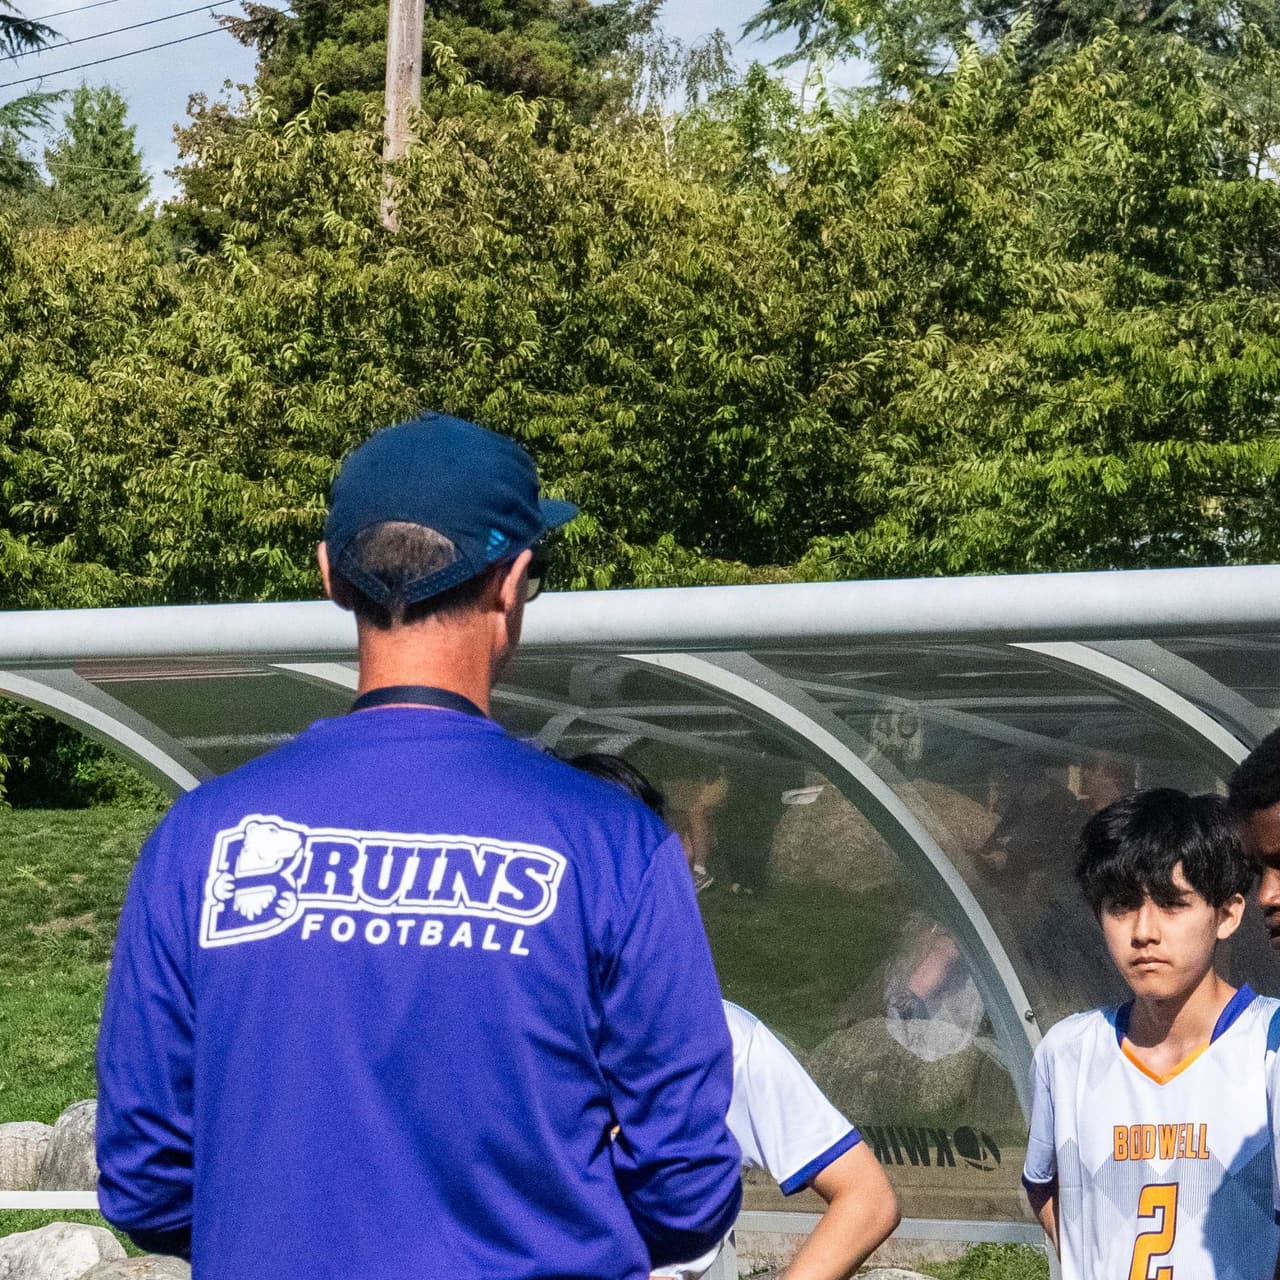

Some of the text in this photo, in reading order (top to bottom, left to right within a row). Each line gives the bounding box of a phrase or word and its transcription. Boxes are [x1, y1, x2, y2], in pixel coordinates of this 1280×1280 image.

[201, 816, 564, 946] BRUINS
[300, 913, 531, 957] FOOTBALL
[1113, 1123, 1210, 1161] BODWELL
